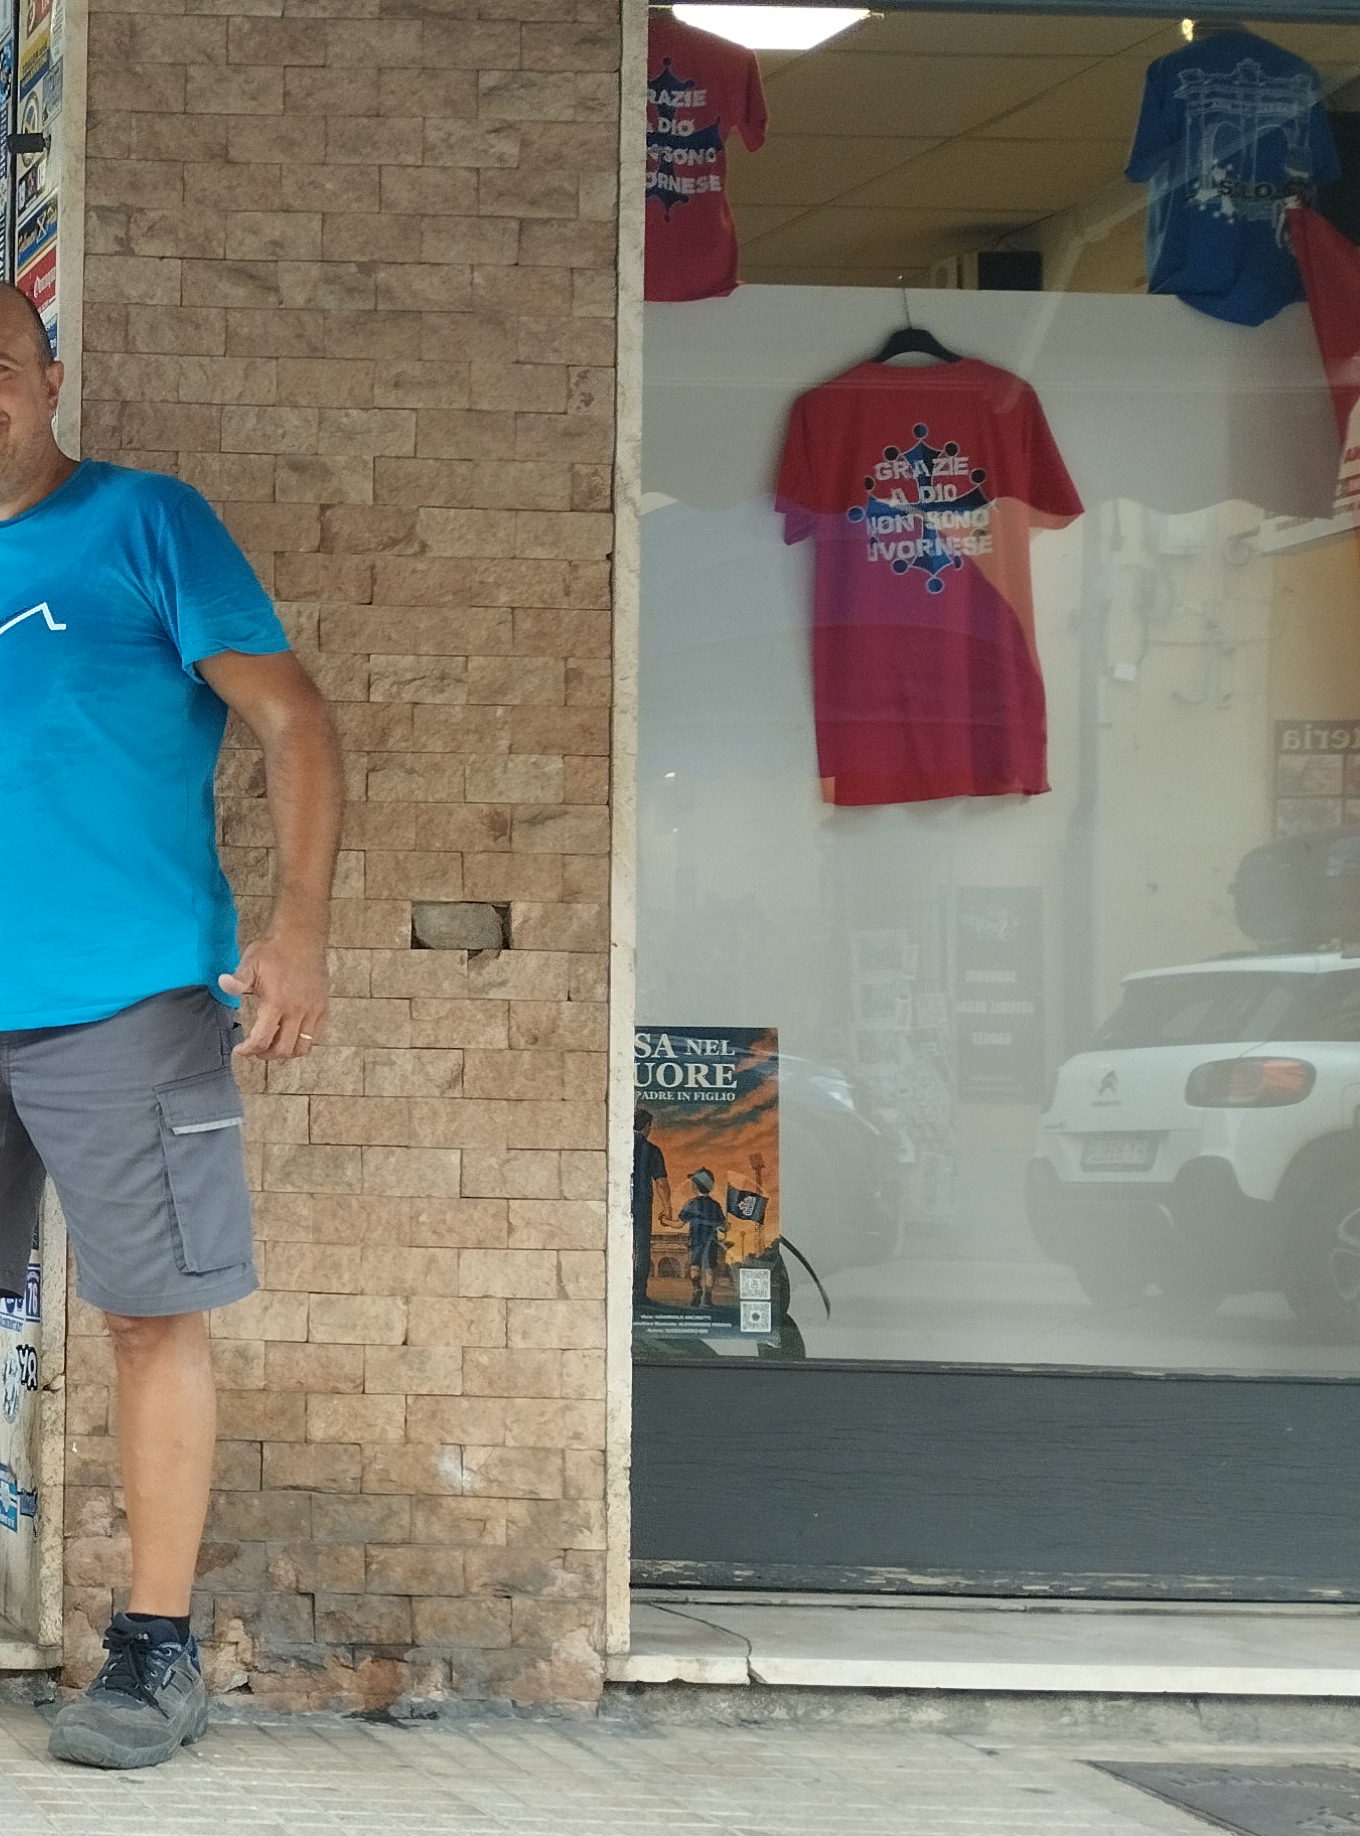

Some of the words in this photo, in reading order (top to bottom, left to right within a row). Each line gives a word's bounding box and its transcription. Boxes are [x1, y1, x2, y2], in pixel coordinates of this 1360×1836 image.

[647, 88, 707, 108] RAZIE
[659, 117, 694, 137] DIO
[645, 171, 721, 194] ORNESE
[874, 456, 969, 481] GRAZIE
[890, 487, 910, 506] A
[920, 484, 957, 504] DIO
[925, 509, 990, 530] SONO
[634, 1033, 678, 1059] SA
[683, 1039, 736, 1056] NEL
[634, 1062, 738, 1089] UORE
[678, 1091, 690, 1101] IN
[694, 1091, 736, 1101] FIGLIO
